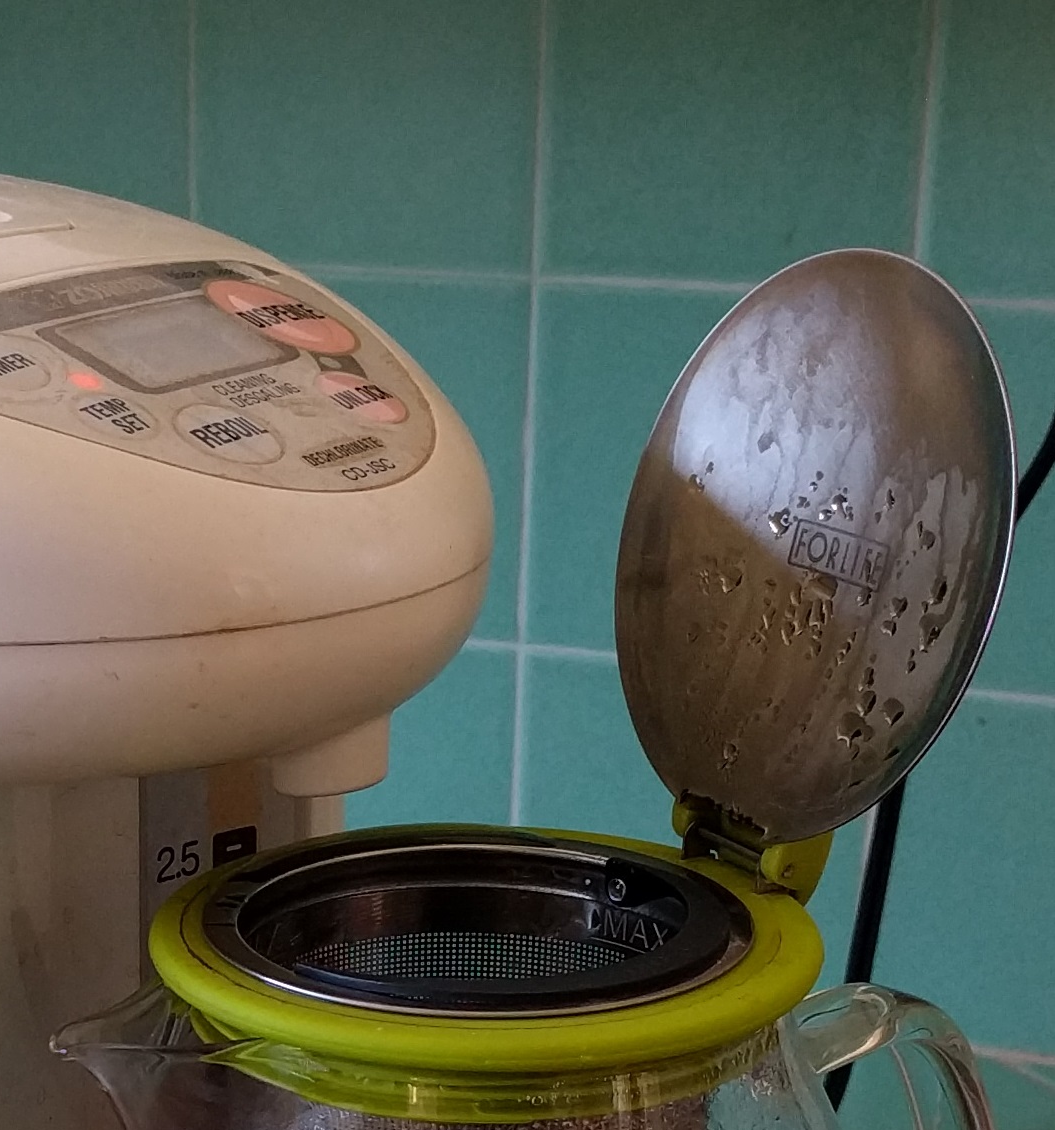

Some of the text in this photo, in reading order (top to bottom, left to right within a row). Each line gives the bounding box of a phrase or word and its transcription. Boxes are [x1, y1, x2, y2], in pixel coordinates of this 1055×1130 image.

[235, 303, 325, 328] DISPENSE
[211, 373, 277, 396] CLEANING
[229, 382, 301, 408] DESCALING
[330, 384, 394, 411] UNLOCK
[79, 398, 131, 421] TEMP
[111, 412, 151, 434] SET
[189, 416, 270, 449] REBOIL
[301, 435, 385, 468] DECHLORINATE
[341, 458, 396, 481] CD-JSC
[156, 840, 201, 883] 2.5
[603, 908, 669, 951] MAX
